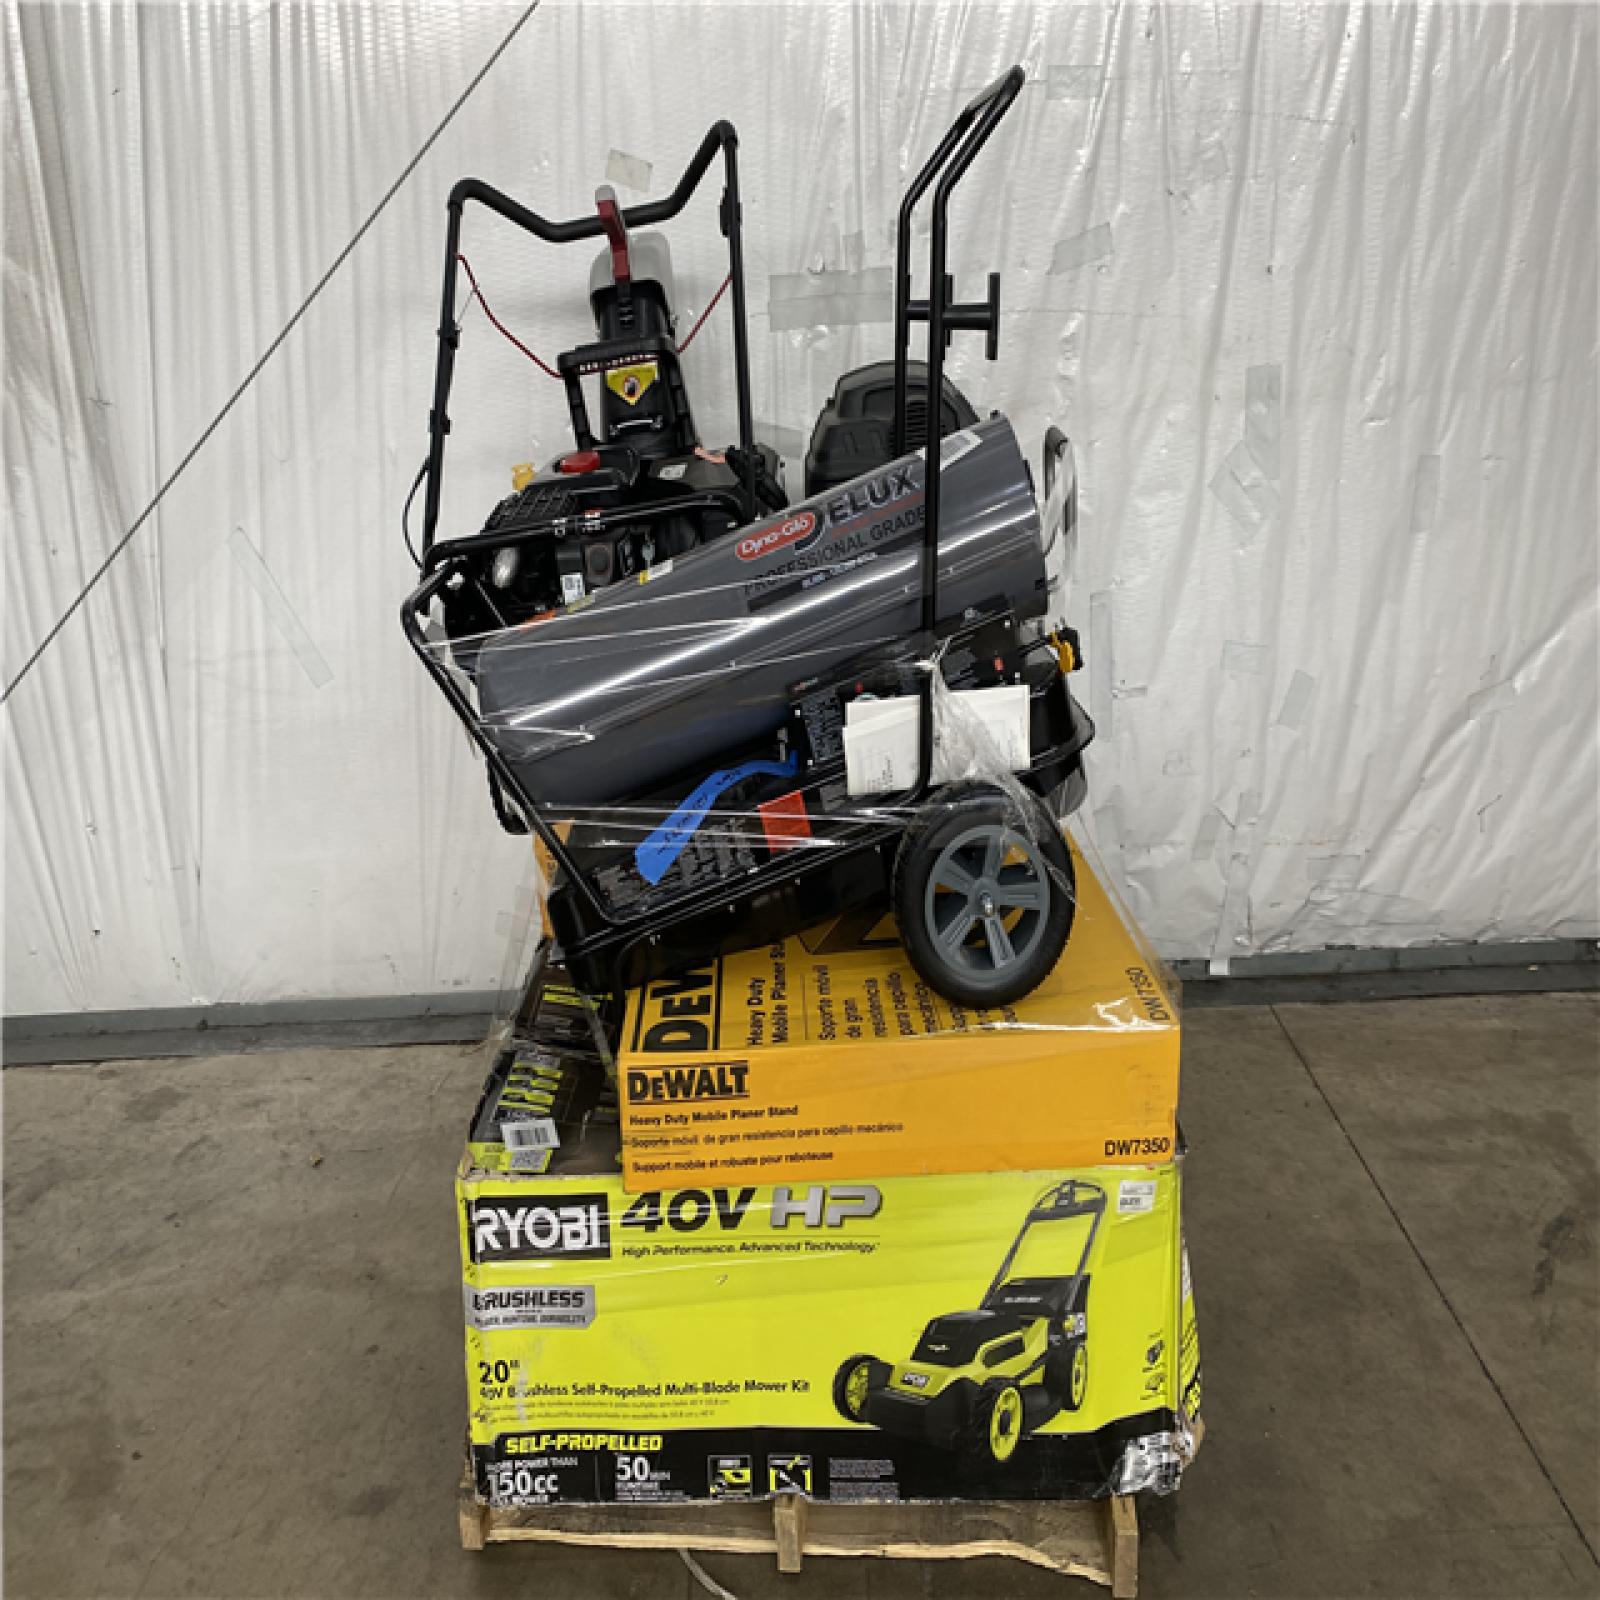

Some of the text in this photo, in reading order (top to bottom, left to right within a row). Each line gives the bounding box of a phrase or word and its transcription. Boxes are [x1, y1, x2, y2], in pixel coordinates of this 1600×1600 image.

[741, 519, 809, 554] Dyno-Glo
[744, 533, 868, 596] PROFESSIONAL
[1125, 966, 1171, 1022] DW7350
[629, 1104, 799, 1128] Heavy Duty Mobile Planer Stand
[1103, 1136, 1171, 1158] DW7350
[632, 1160, 671, 1174] Support
[673, 1157, 706, 1171] mobile
[619, 1184, 883, 1232] 40V HP
[473, 1203, 604, 1252] RYOBI
[622, 1246, 651, 1259] High
[507, 1383, 569, 1399] Bushless
[571, 1381, 662, 1400] Self-Propelled
[664, 1380, 741, 1397] Multi-Blade
[744, 1379, 789, 1394] Mower
[791, 1378, 811, 1392] Kit
[504, 1433, 664, 1455] SELF-PROPELLED
[549, 1455, 579, 1467] THAN
[615, 1455, 650, 1482] 50
[486, 1470, 560, 1498] 150cc
